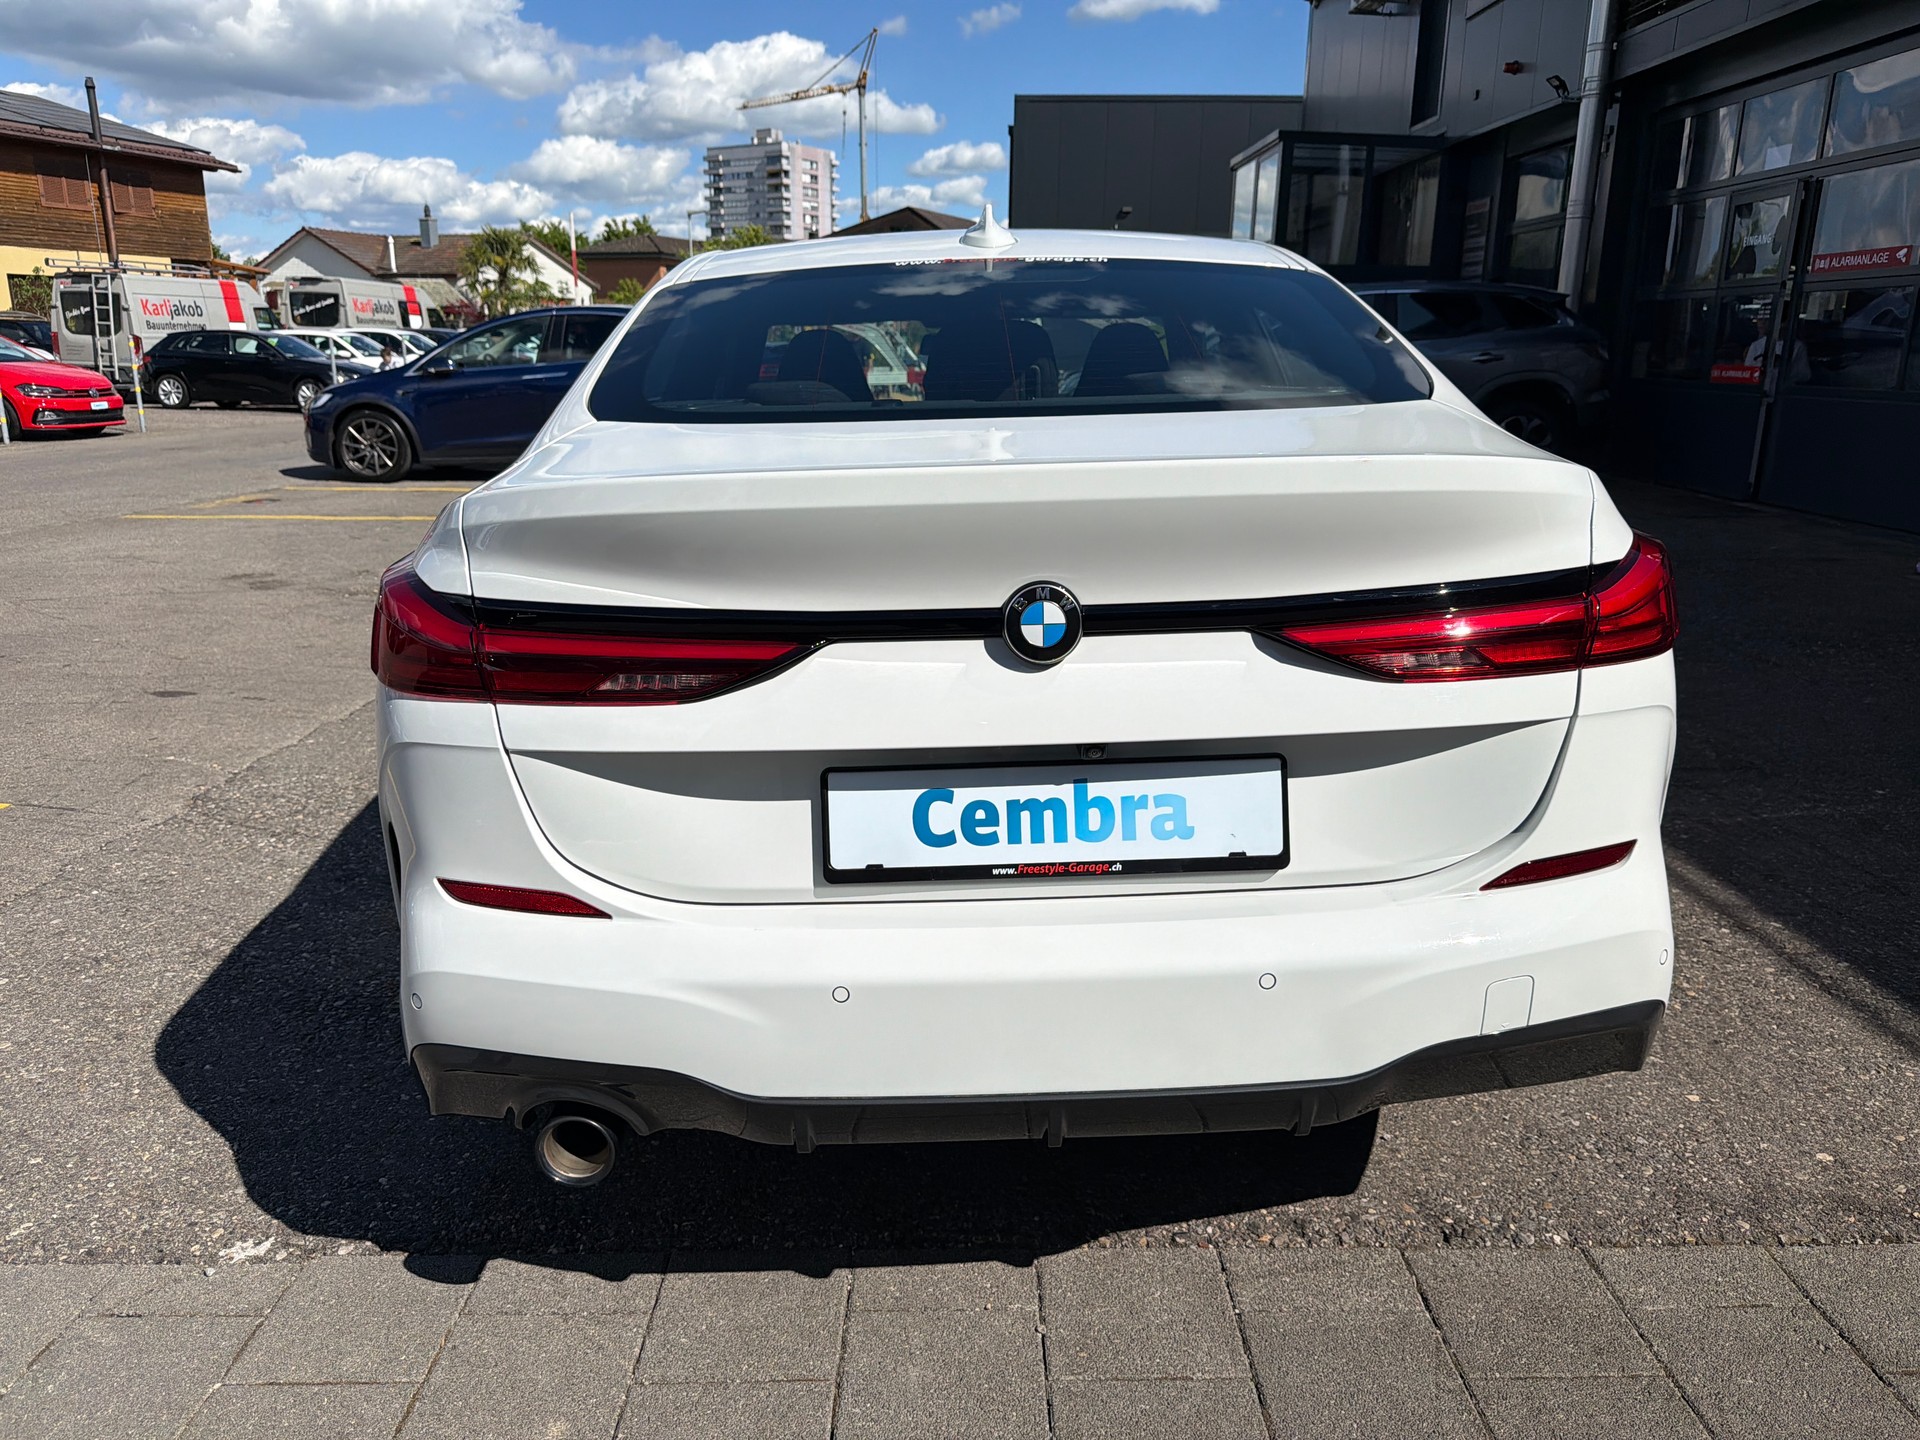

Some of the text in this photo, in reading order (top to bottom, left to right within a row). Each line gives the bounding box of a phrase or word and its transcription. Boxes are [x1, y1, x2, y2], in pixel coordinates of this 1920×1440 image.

[1743, 235, 1773, 247] EINGANG
[1830, 251, 1890, 268] ALARMANLAGE
[140, 298, 204, 320] Karljakob
[1012, 587, 1075, 612] BMW
[911, 778, 1195, 848] Cembra
[992, 862, 1122, 876] www.Freestyle-Garage.ch
